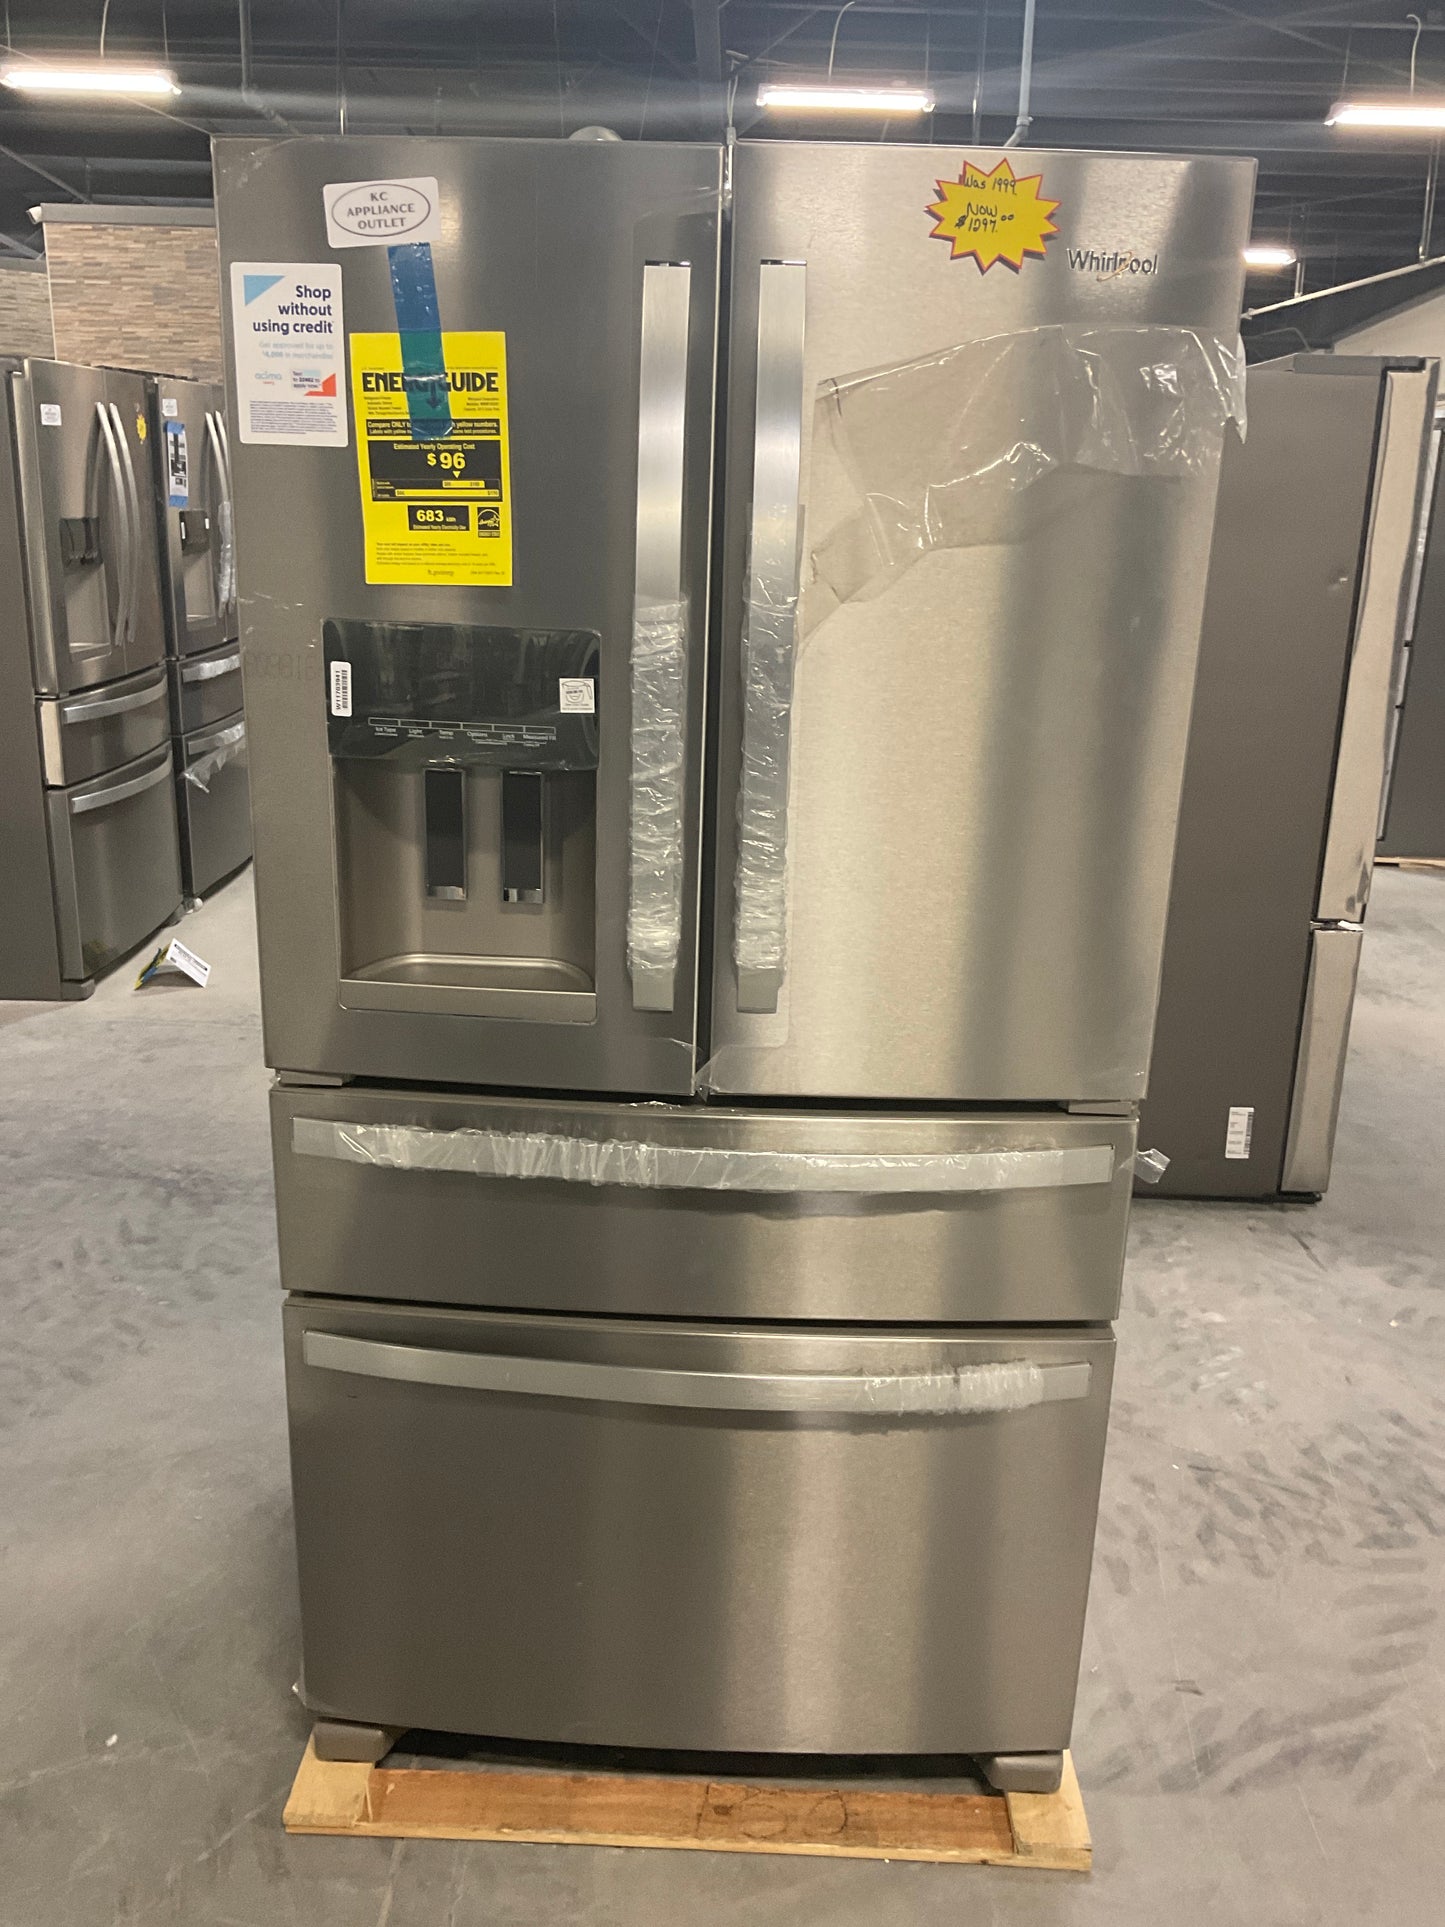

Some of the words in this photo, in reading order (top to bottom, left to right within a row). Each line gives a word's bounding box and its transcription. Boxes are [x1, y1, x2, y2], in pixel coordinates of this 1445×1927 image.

[964, 174, 986, 189] Was
[370, 191, 388, 201] KC
[347, 203, 415, 216] APPLIANCE
[357, 217, 406, 229] OUTLET
[1067, 248, 1158, 279] Whirlpool
[295, 285, 331, 301] Shop
[278, 302, 332, 316] without
[253, 319, 289, 335] using
[293, 321, 333, 333] credit
[367, 421, 391, 429] Compare
[456, 421, 473, 429] yellow
[420, 443, 436, 451] Yearly
[437, 443, 462, 451] Operating
[440, 452, 466, 469] 96
[416, 509, 444, 522] 683
